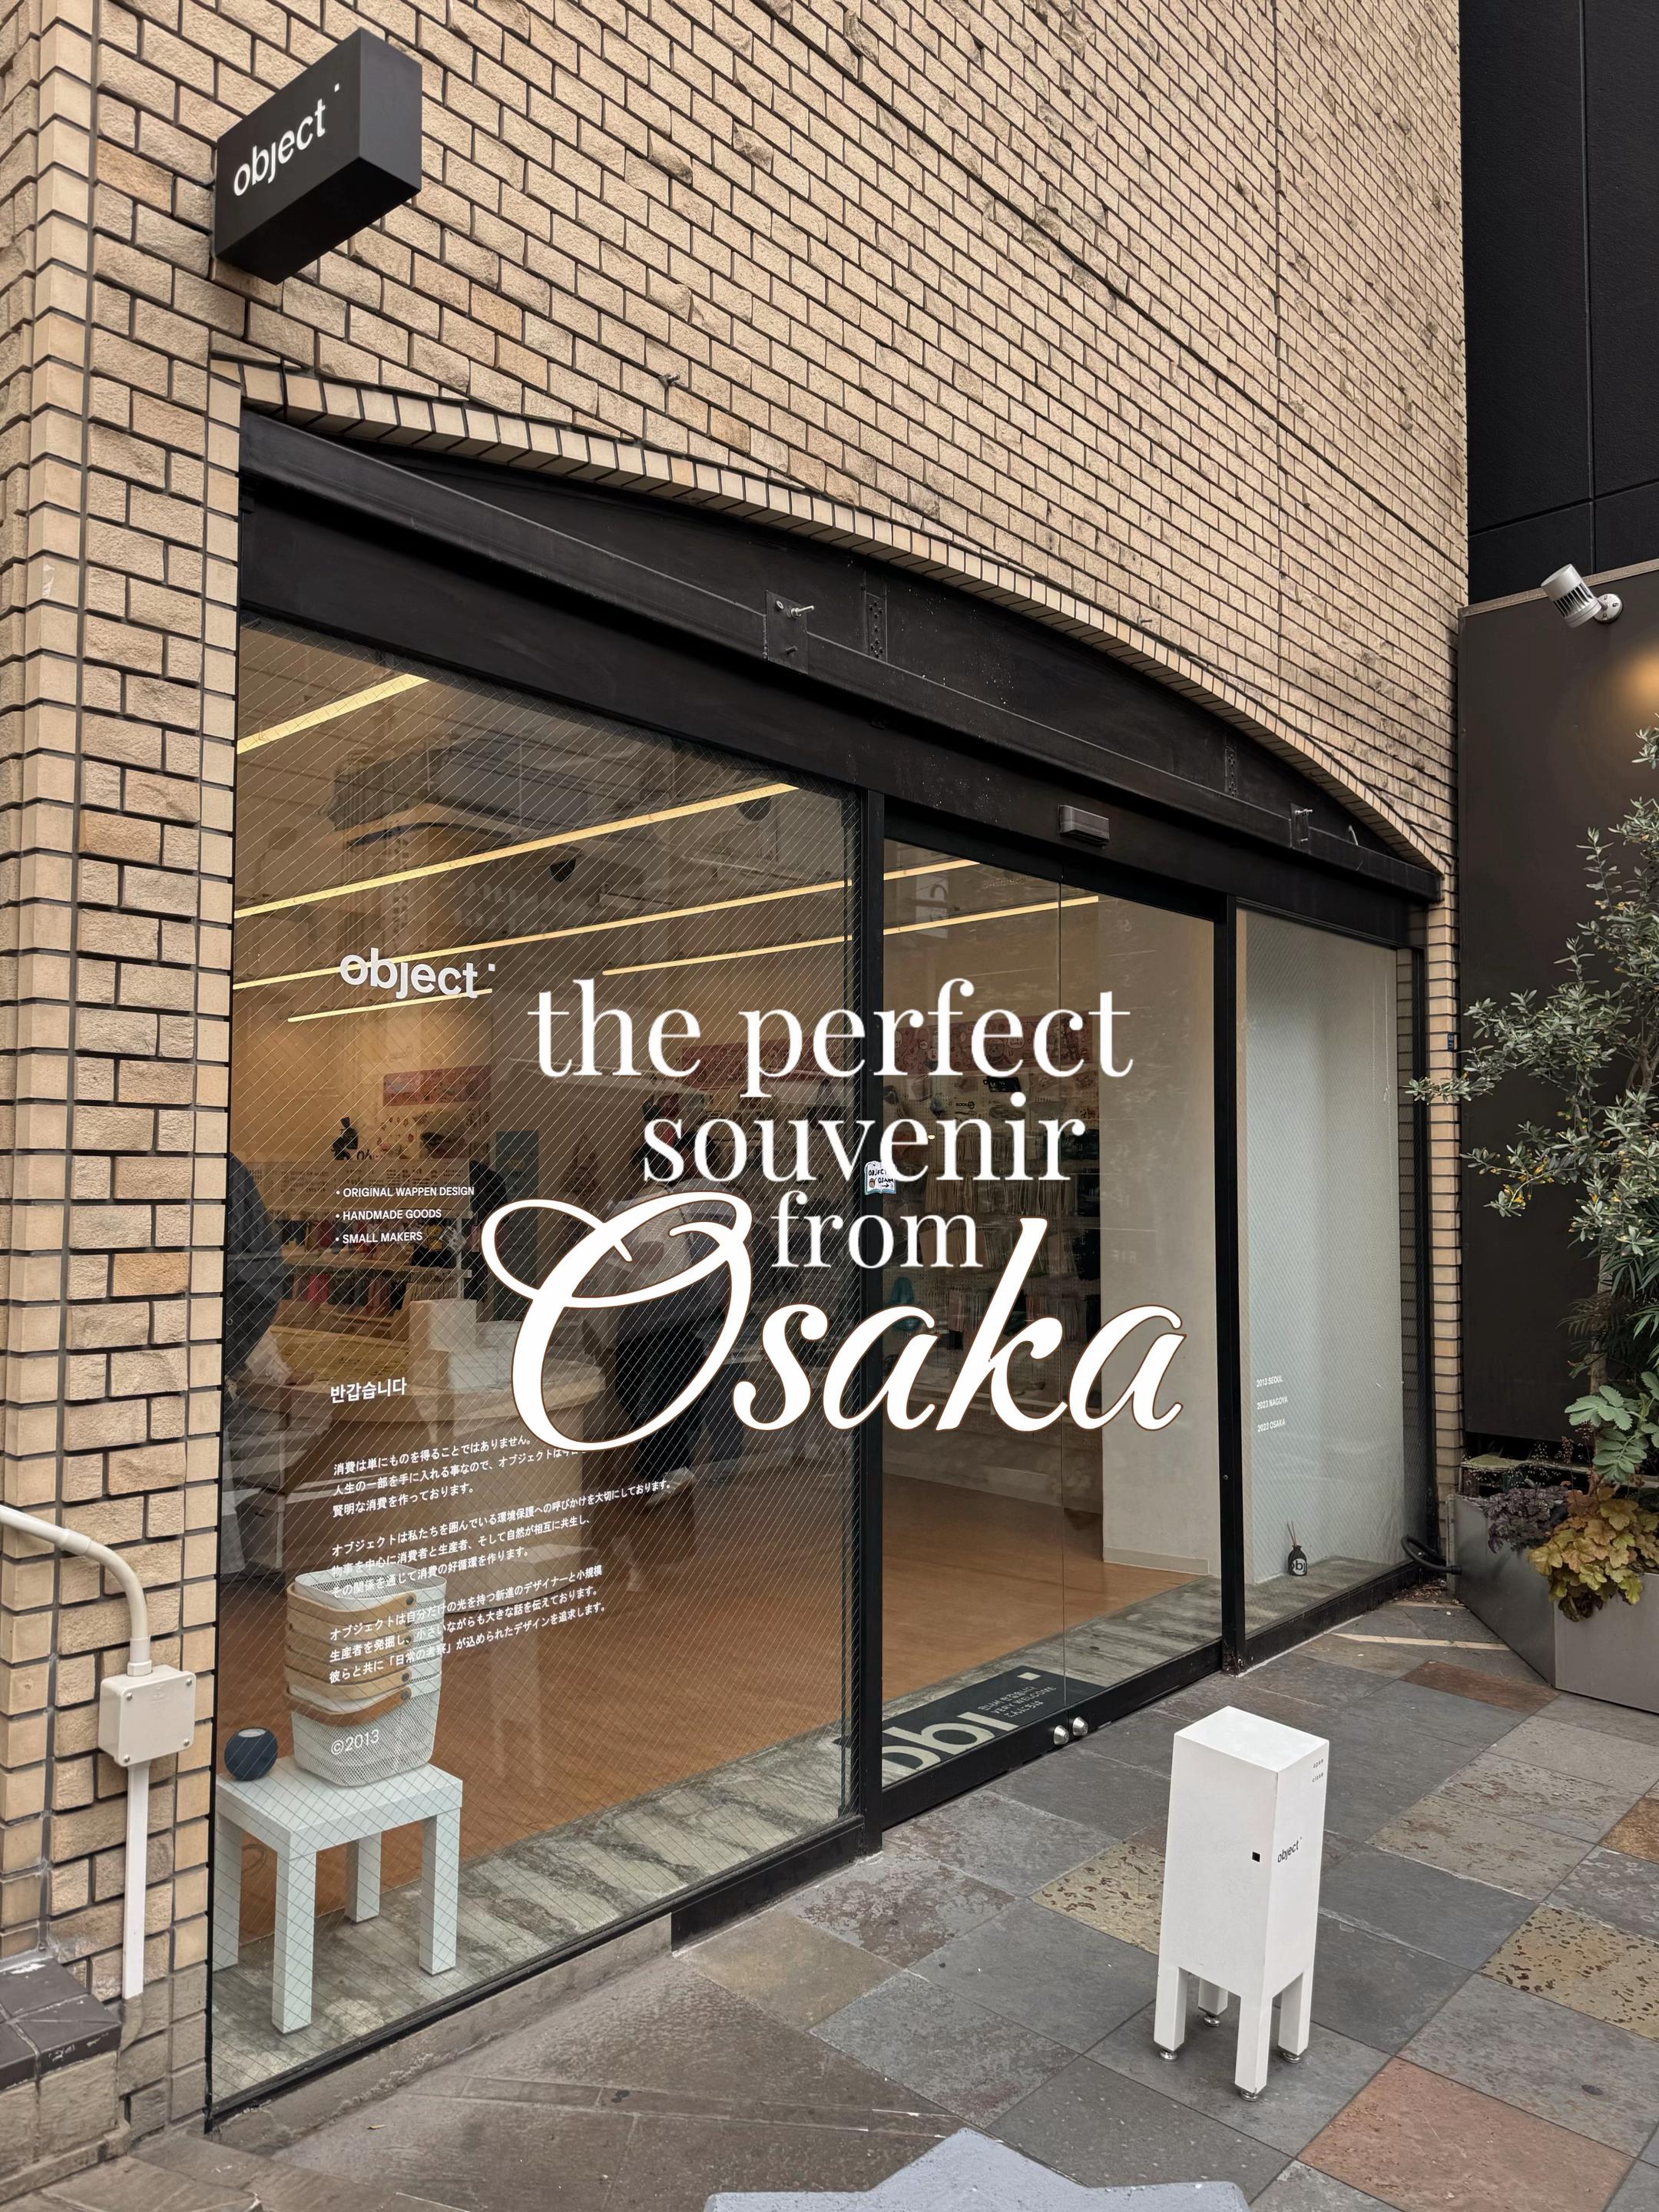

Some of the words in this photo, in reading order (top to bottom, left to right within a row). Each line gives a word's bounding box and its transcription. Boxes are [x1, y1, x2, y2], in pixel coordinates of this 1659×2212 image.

[233, 98, 326, 197] object
[339, 948, 478, 999] object
[343, 1187, 393, 1197] ORIGINAL
[396, 1187, 437, 1197] WAPPEN
[439, 1186, 475, 1196] DESIGN
[343, 1210, 403, 1220] HANDMADE
[405, 1209, 442, 1219] GOODS
[342, 1233, 378, 1244] SMALL
[380, 1231, 423, 1242] MAKERS
[1256, 1377, 1267, 1387] 2013
[1268, 1375, 1283, 1385] SEOUL
[329, 1376, 407, 1404] 반갑습니다
[1269, 1396, 1289, 1407] NAGOYA
[1269, 1418, 1286, 1429] OSAKA
[989, 1702, 1015, 1714] VERY
[1012, 1685, 1057, 1704] WELCOME
[1277, 1839, 1300, 1863] object
